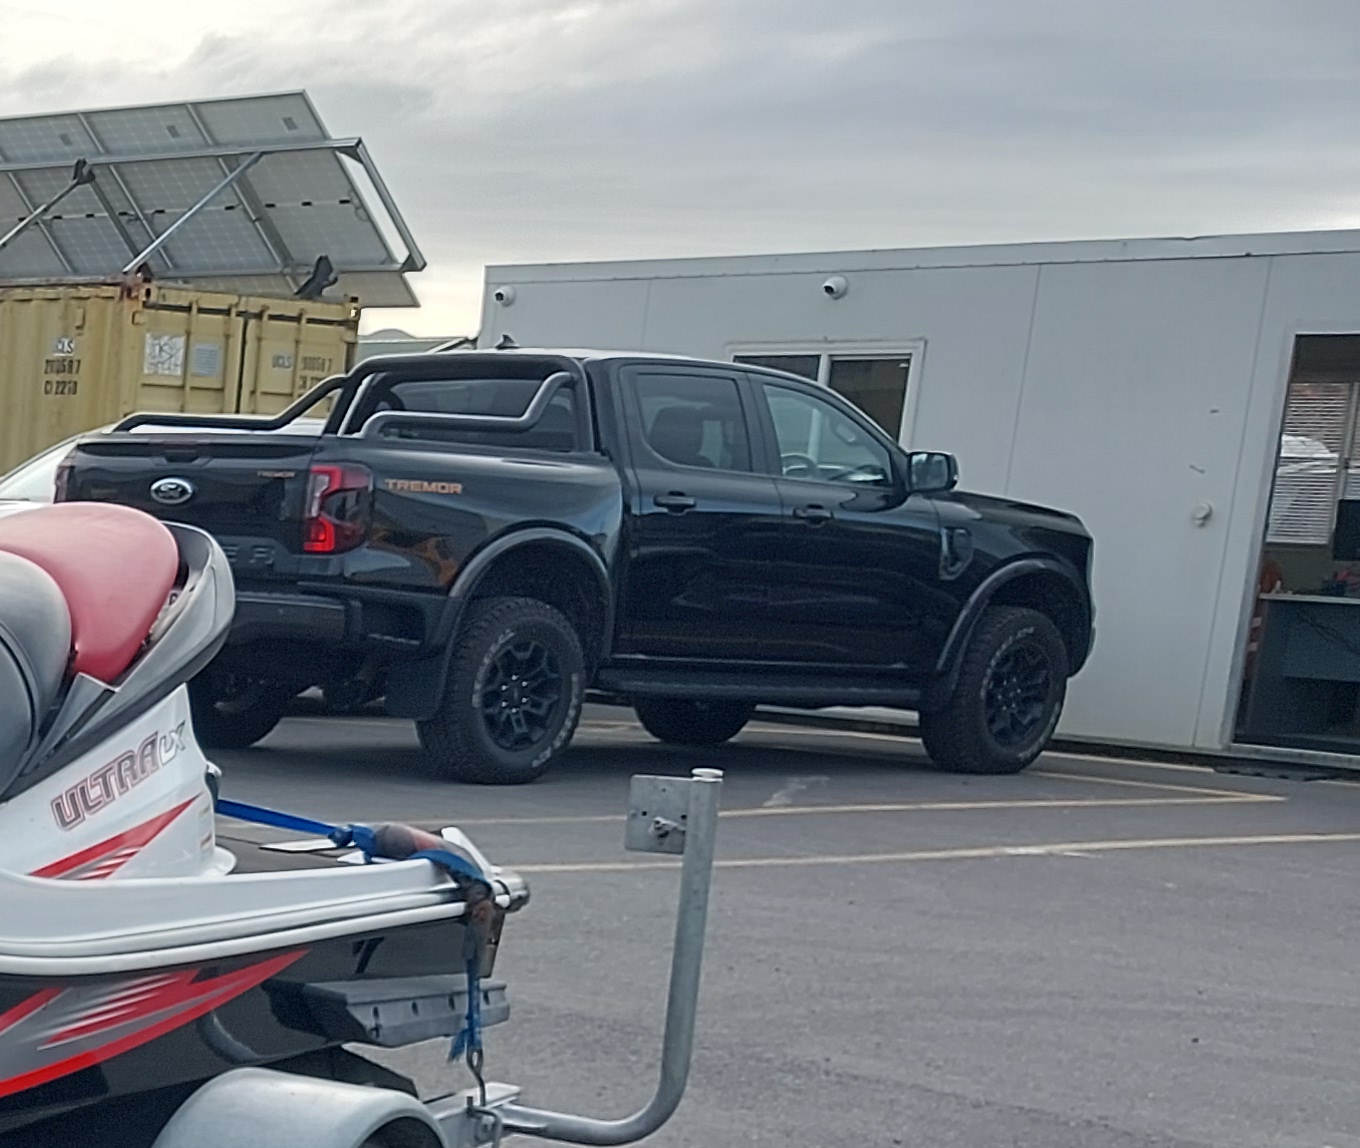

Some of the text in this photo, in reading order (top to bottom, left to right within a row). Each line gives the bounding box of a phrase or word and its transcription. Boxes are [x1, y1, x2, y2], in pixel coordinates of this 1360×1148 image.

[385, 479, 463, 494] TREMOR
[50, 719, 186, 832] ULTRA LX
